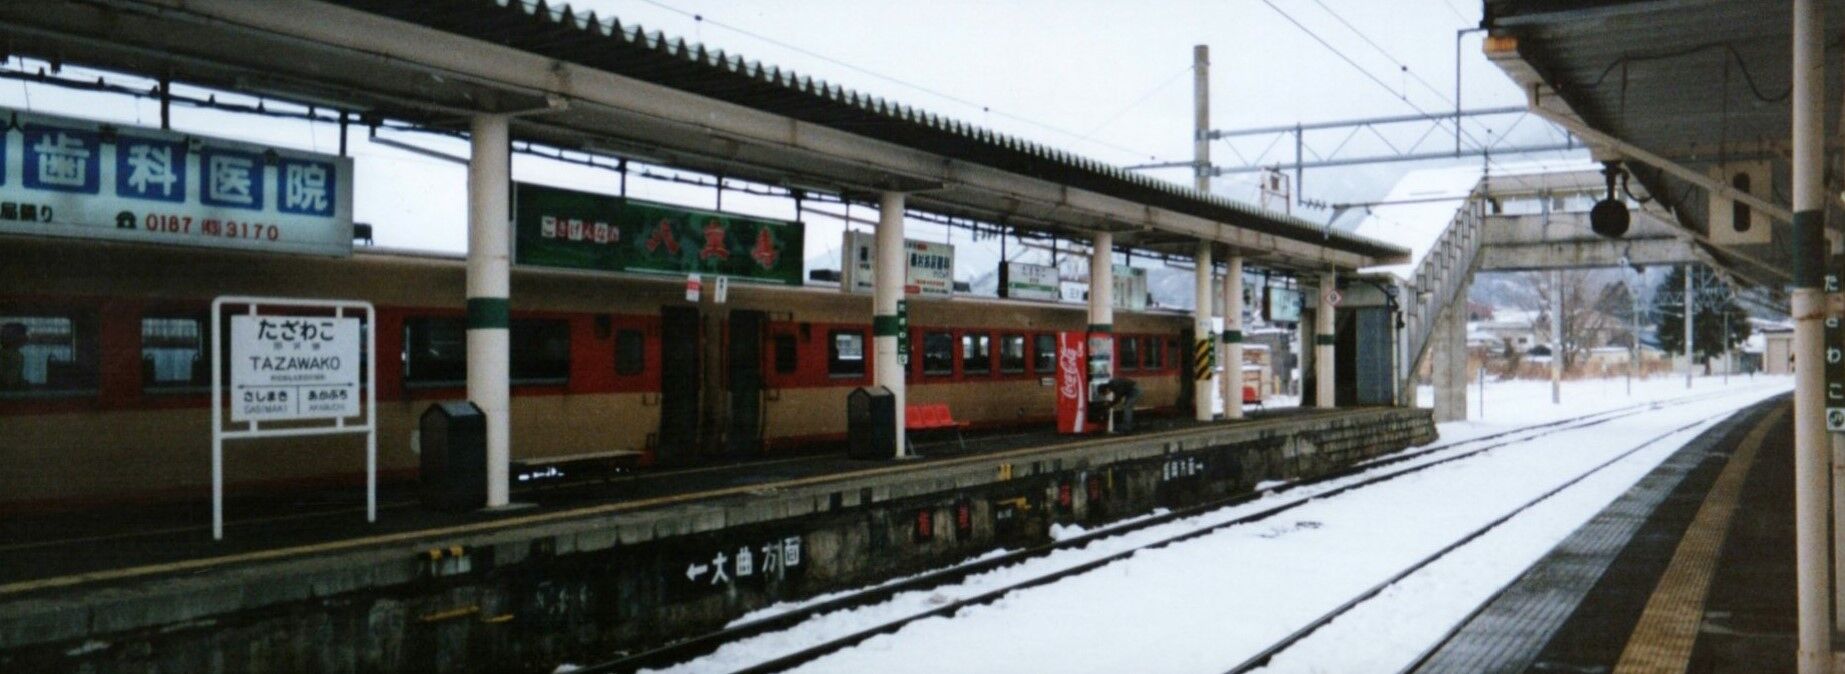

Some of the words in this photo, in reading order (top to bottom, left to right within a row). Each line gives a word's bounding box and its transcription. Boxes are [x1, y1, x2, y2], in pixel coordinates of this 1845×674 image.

[34, 133, 327, 211] 歯科医院
[146, 214, 192, 234] 0187
[227, 222, 279, 241] 3170
[258, 319, 334, 341] たざわこ
[250, 356, 341, 371] TAZAWAKO
[711, 536, 801, 585] 大曲方面
